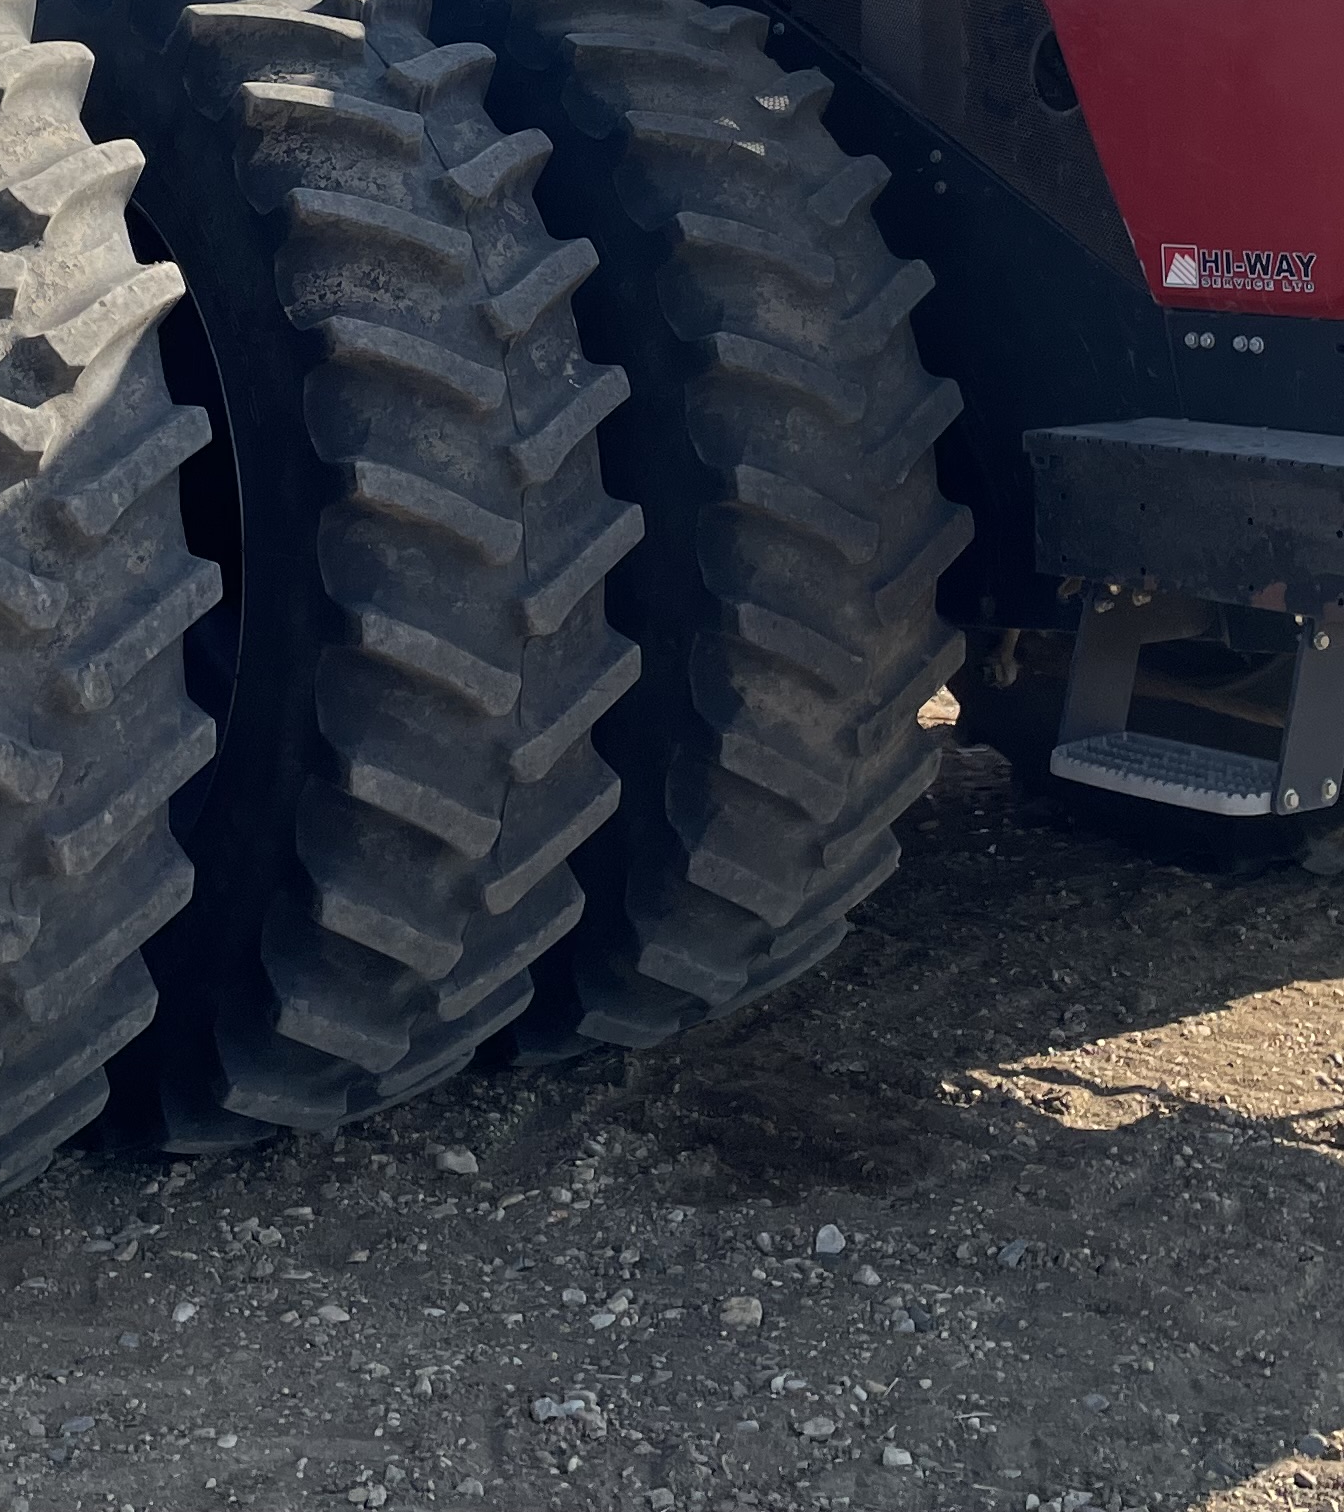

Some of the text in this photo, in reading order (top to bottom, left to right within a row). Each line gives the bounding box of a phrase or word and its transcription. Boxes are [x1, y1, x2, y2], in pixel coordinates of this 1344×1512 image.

[1200, 249, 1317, 280] HI-WAY
[1202, 278, 1314, 292] SERVICE LTD
